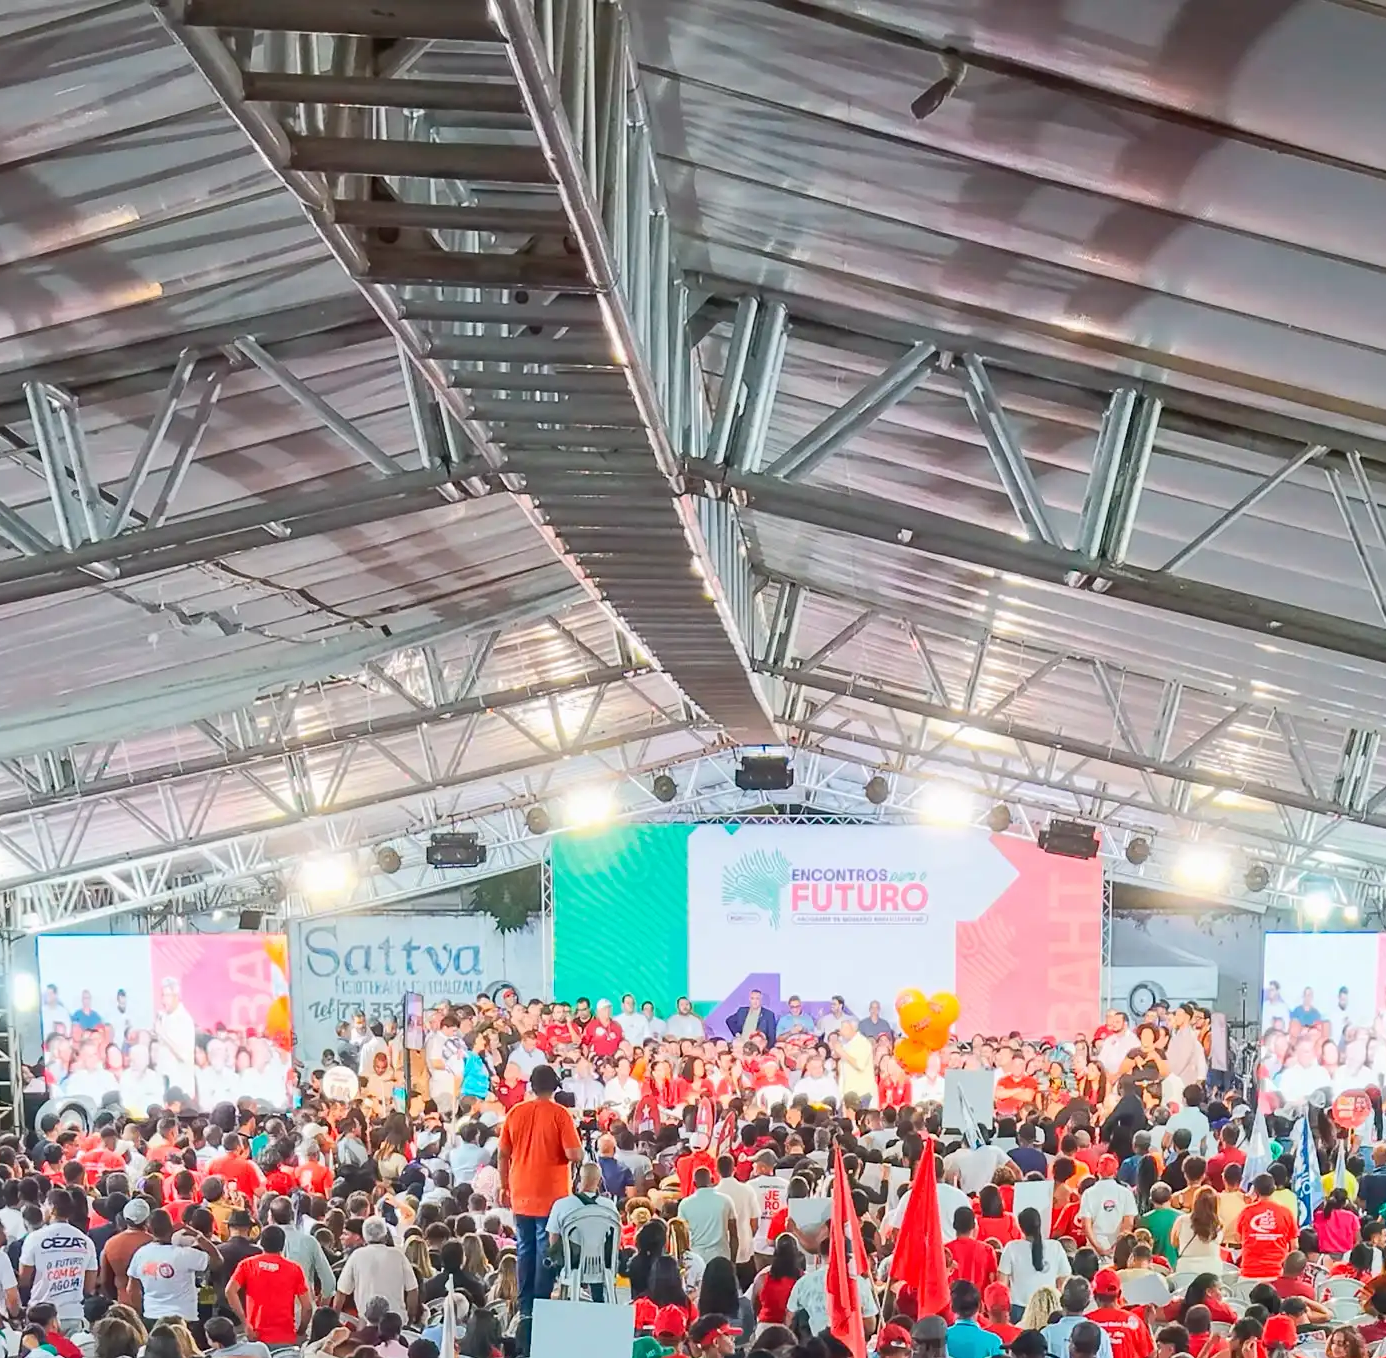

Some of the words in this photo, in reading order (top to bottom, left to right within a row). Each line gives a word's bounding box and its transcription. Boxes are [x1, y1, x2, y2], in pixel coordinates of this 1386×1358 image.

[792, 868, 888, 882] ENCONTROS
[791, 883, 929, 912] FUTURO
[306, 926, 484, 977] Sattva
